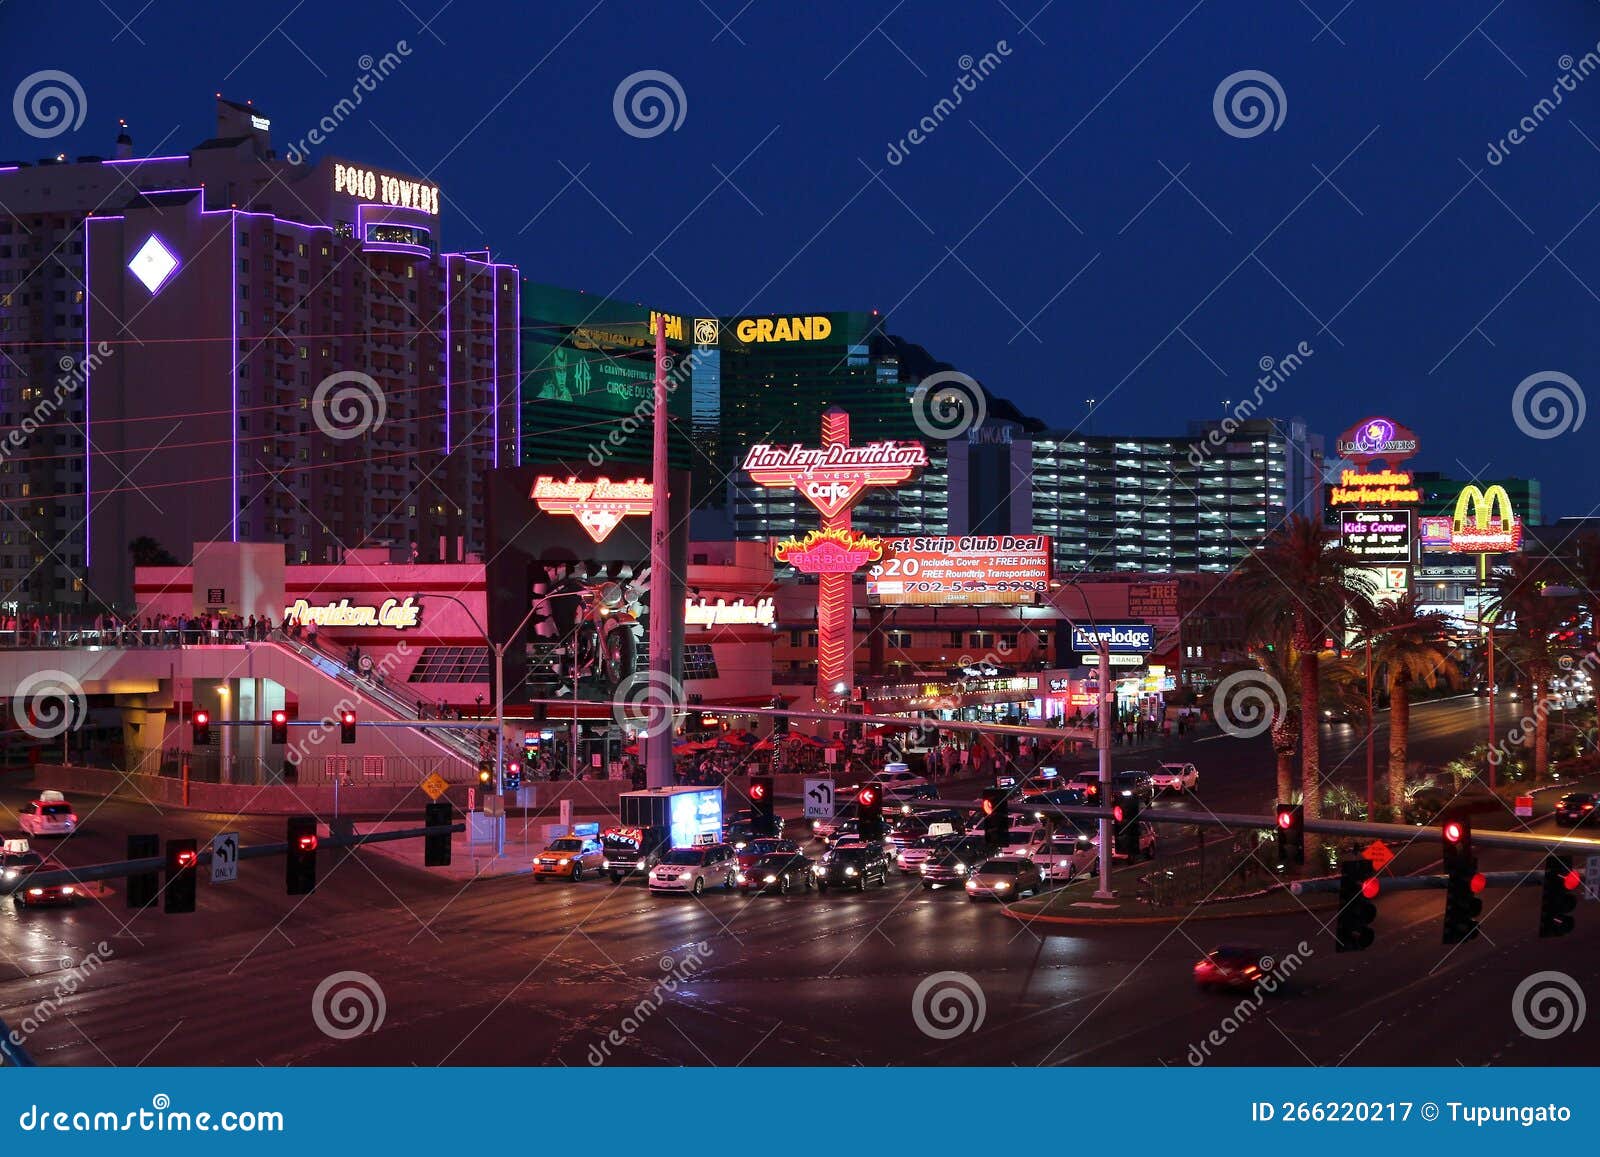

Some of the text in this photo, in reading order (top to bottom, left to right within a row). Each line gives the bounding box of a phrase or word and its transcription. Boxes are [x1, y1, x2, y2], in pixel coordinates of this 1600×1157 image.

[335, 163, 438, 214] POLO TOWERS
[737, 317, 831, 342] GRAND
[607, 381, 633, 400] CIRQUE
[807, 482, 850, 507] Cafe
[1356, 512, 1394, 522] Come to
[1344, 522, 1407, 533] Kids Corner
[914, 537, 956, 555] Strip
[959, 536, 998, 551] Club
[1002, 535, 1044, 551] Deal
[1349, 534, 1402, 544] for all your
[921, 558, 954, 567] Includes
[956, 558, 980, 567] Cover
[996, 557, 1018, 566] FREE
[1020, 557, 1047, 566] Drinks
[921, 569, 1046, 580] FREE Roundtrip Transportation
[379, 597, 419, 629] Cafe
[1073, 628, 1150, 647] Travelodge
[809, 807, 829, 815] ONLY
[215, 865, 233, 878] ONLY
